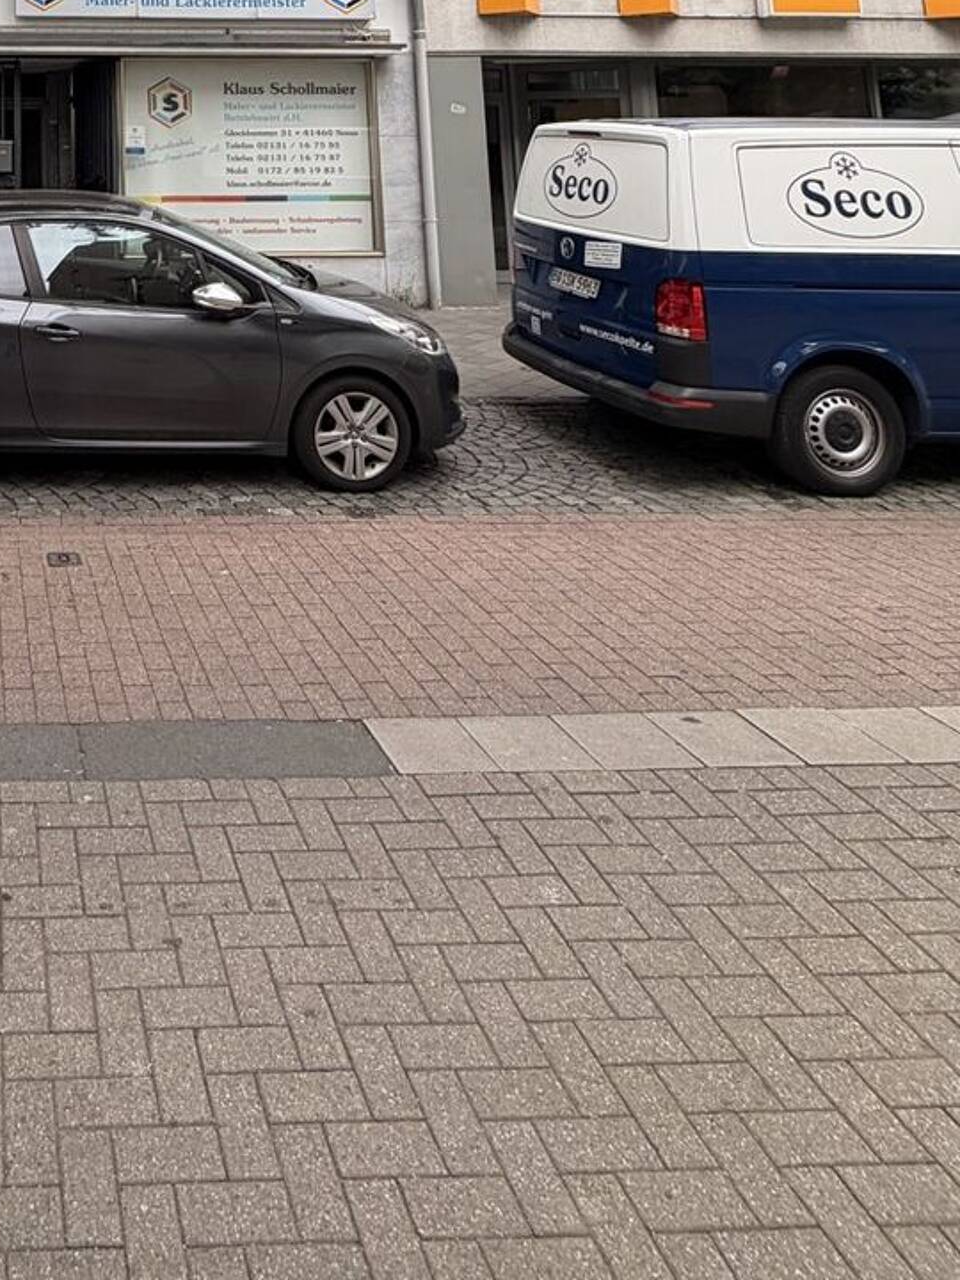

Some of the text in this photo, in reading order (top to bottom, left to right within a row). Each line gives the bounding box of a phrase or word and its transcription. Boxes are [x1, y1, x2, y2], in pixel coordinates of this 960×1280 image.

[163, 93, 179, 112] S
[224, 82, 356, 96] Klaus Schollmaier
[549, 165, 609, 205] Seco
[800, 179, 913, 219] Seco
